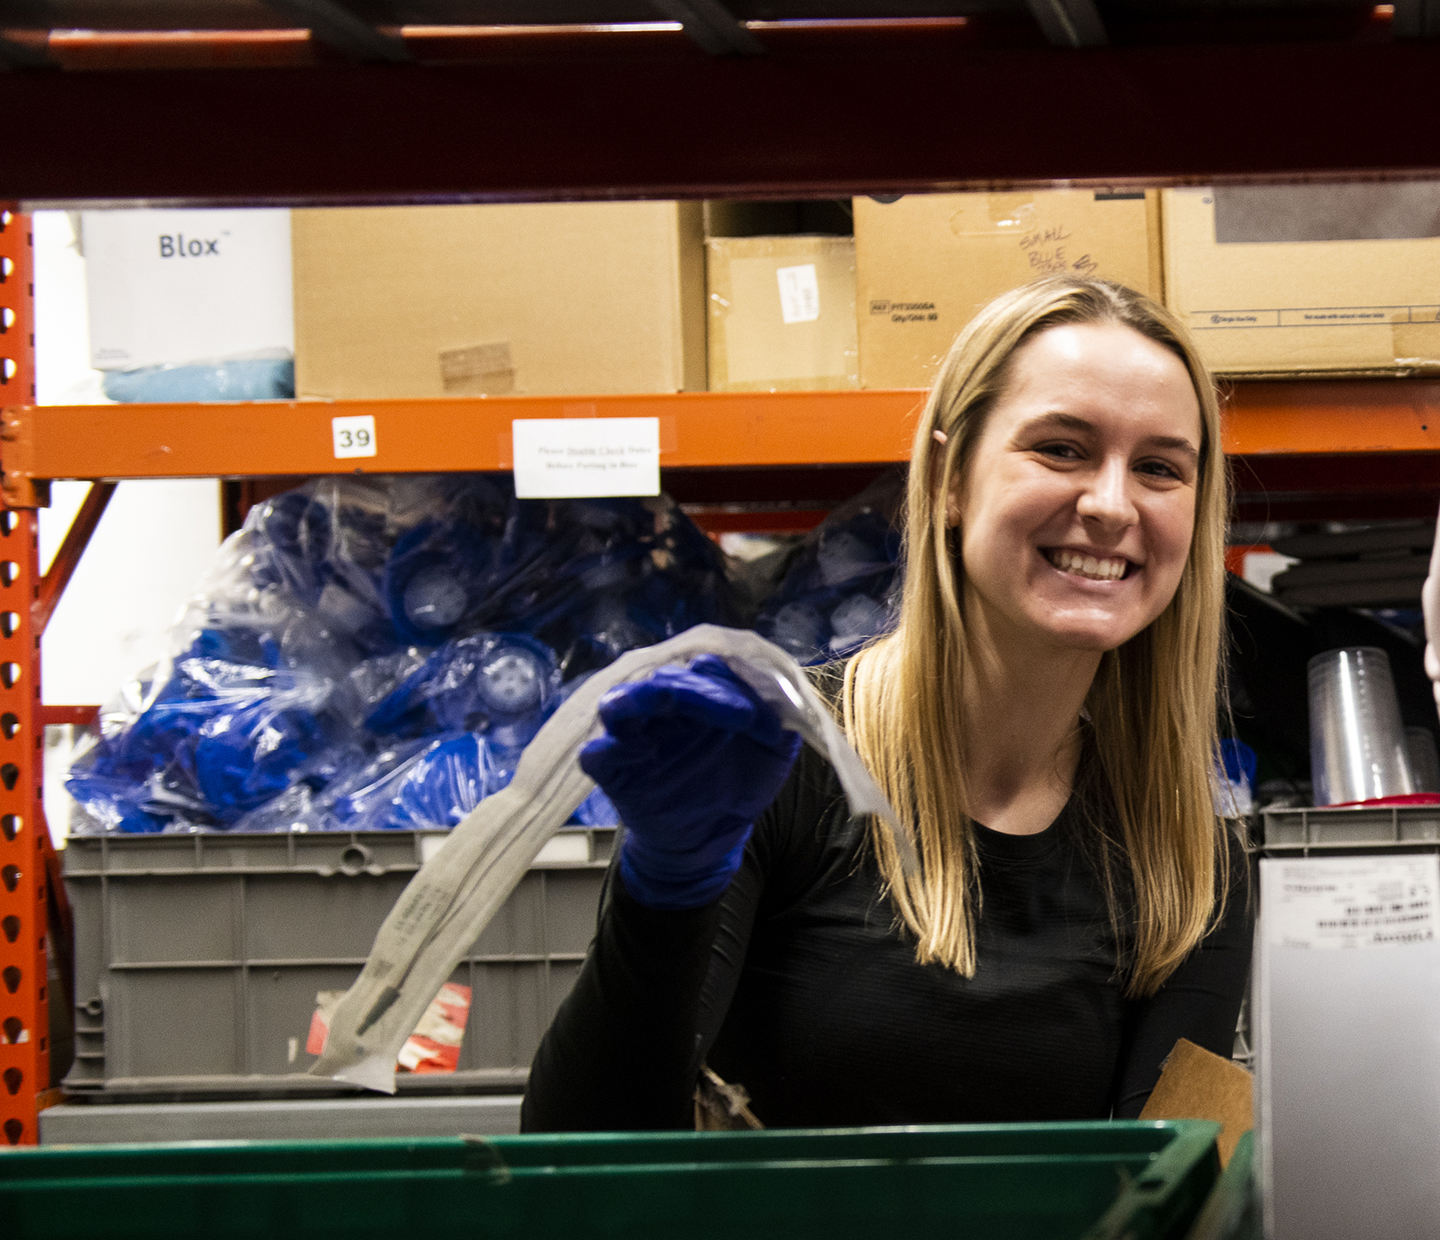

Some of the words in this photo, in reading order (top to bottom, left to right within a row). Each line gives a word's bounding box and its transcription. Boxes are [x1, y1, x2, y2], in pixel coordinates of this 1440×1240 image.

[159, 233, 219, 258] Blox
[1019, 224, 1072, 250] SMALL
[1028, 246, 1067, 267] BLUE
[338, 429, 370, 447] 39
